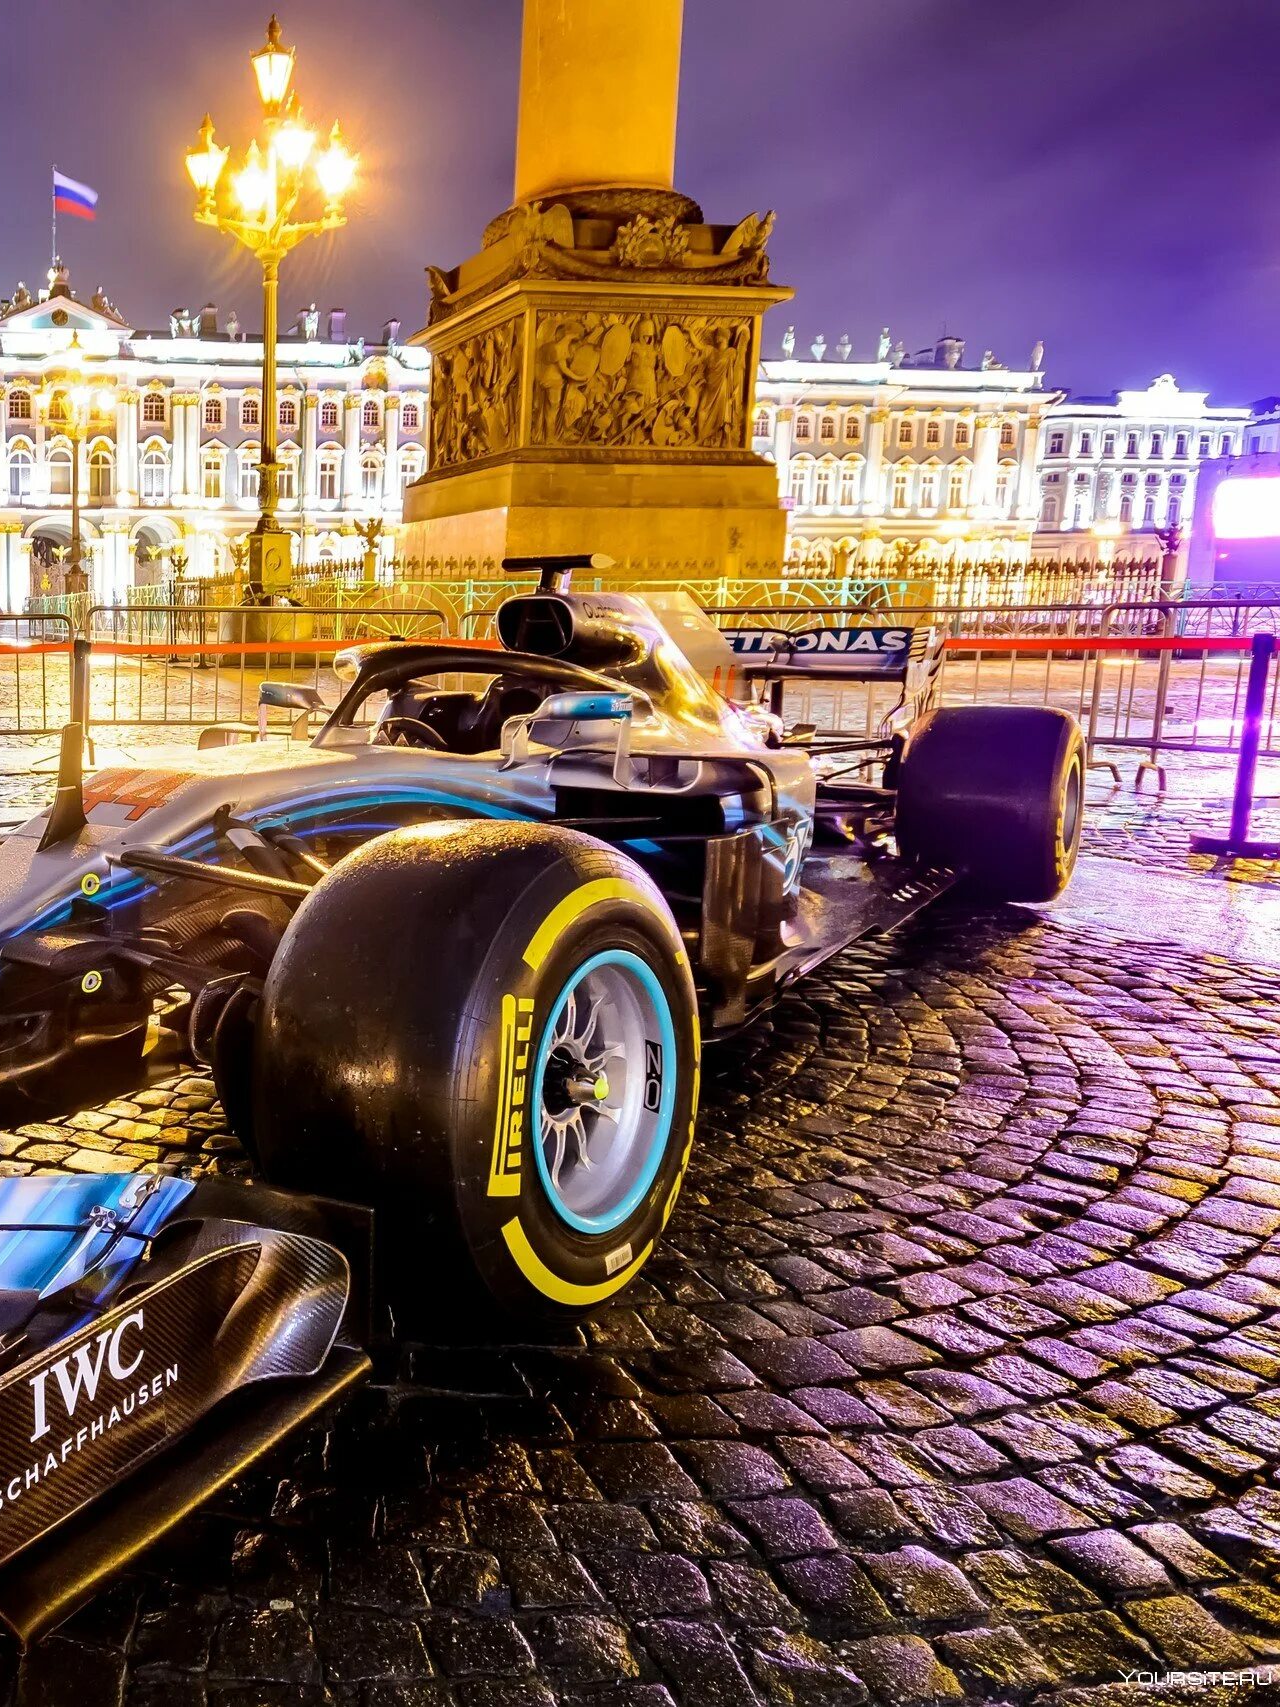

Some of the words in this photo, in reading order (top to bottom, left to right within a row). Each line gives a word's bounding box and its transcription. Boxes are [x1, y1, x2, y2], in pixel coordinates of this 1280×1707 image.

[81, 768, 196, 821] 44
[487, 994, 535, 1196] PIRELLI
[29, 1309, 144, 1443] IWC
